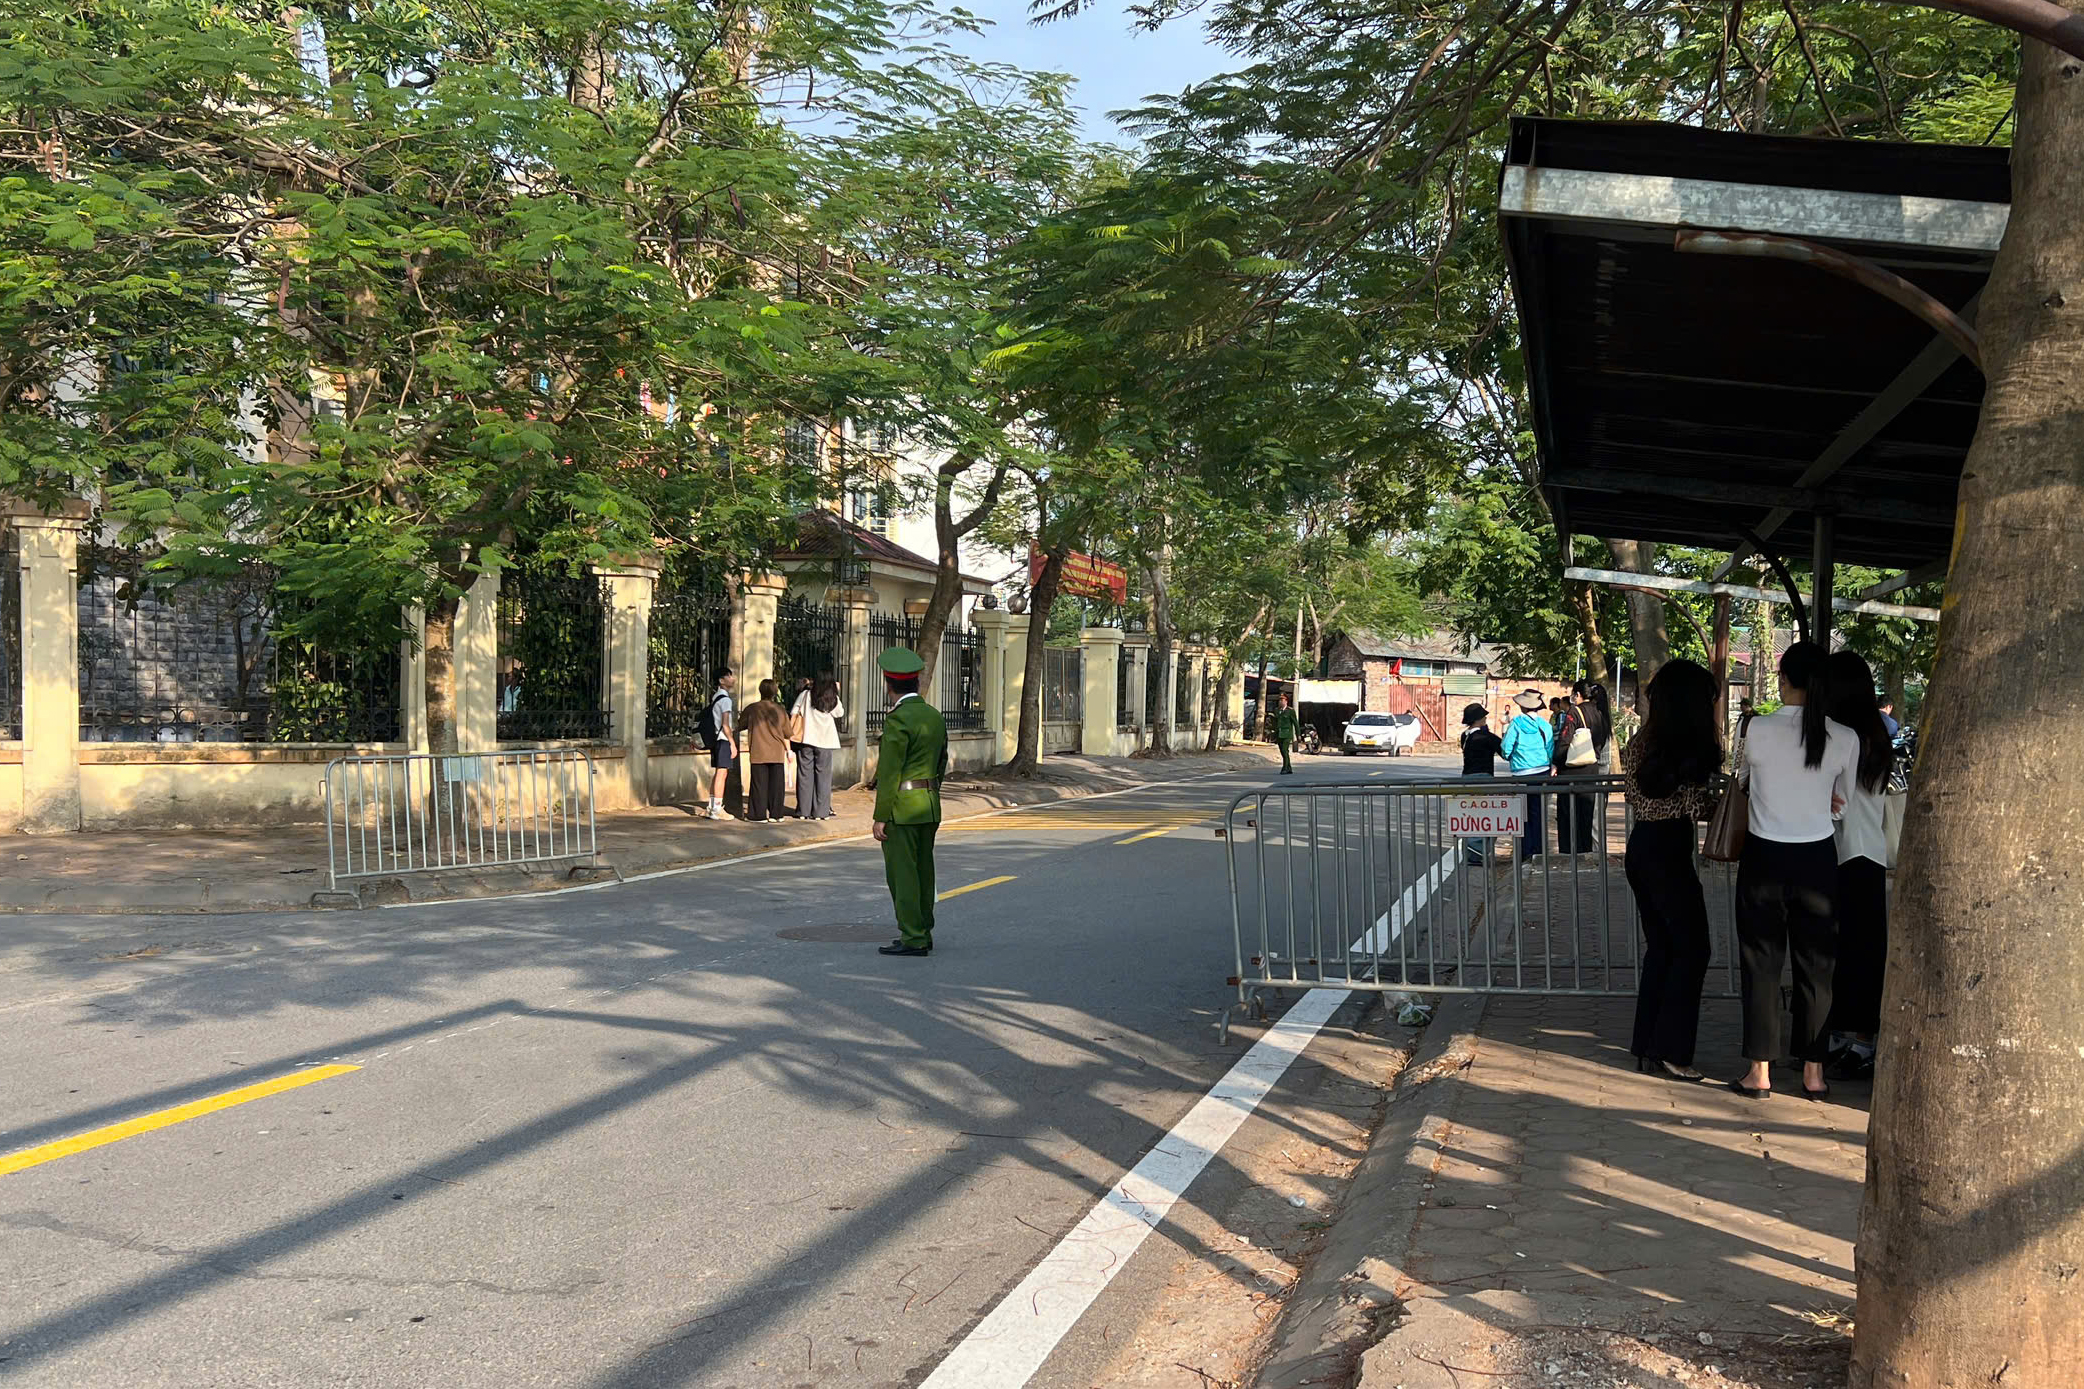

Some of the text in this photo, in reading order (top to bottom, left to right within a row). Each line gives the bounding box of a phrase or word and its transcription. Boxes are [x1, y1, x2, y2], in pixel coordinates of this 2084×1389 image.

[1460, 800, 1508, 809] C.A.Q.L.B
[1450, 813, 1519, 835] DỪNG LẠI
